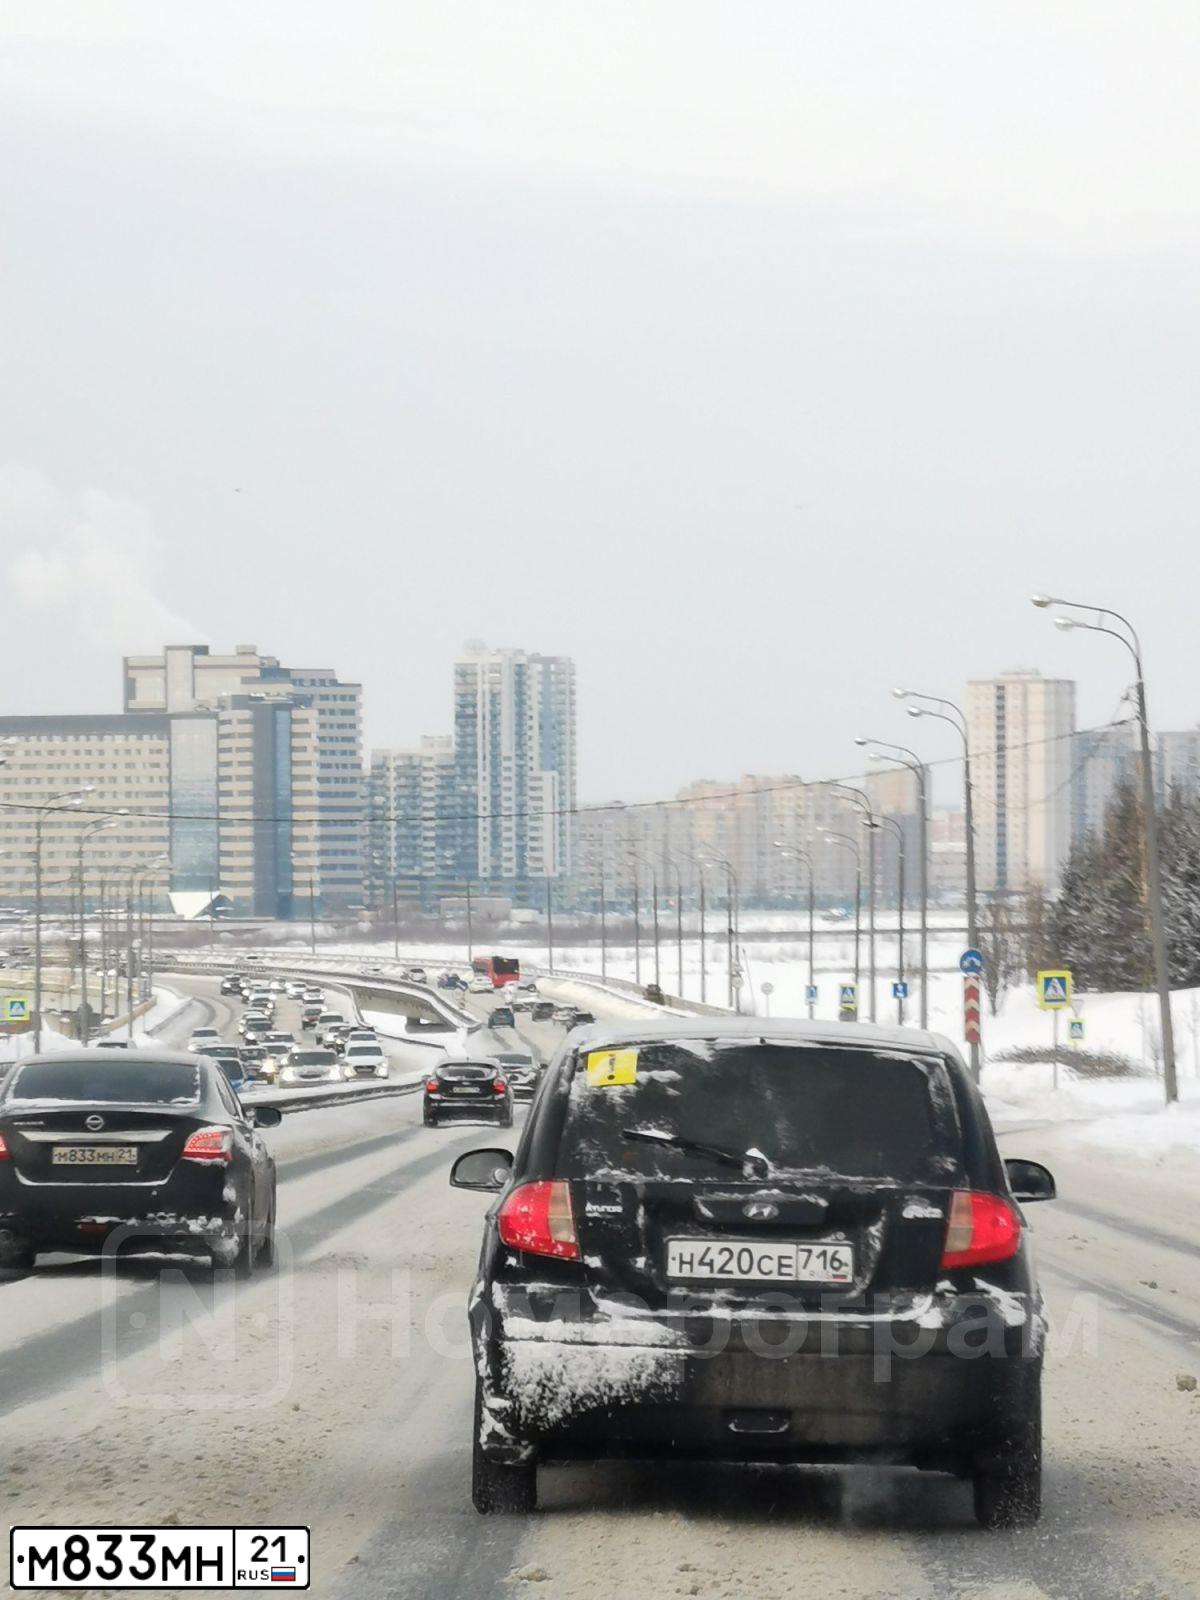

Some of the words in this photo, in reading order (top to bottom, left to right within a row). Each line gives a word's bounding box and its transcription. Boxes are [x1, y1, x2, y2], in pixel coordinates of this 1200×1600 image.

[58, 1149, 114, 1162] М833МН
[118, 1148, 132, 1159] 21
[678, 1246, 793, 1277] Н420СЕ
[798, 1248, 843, 1272] 716
